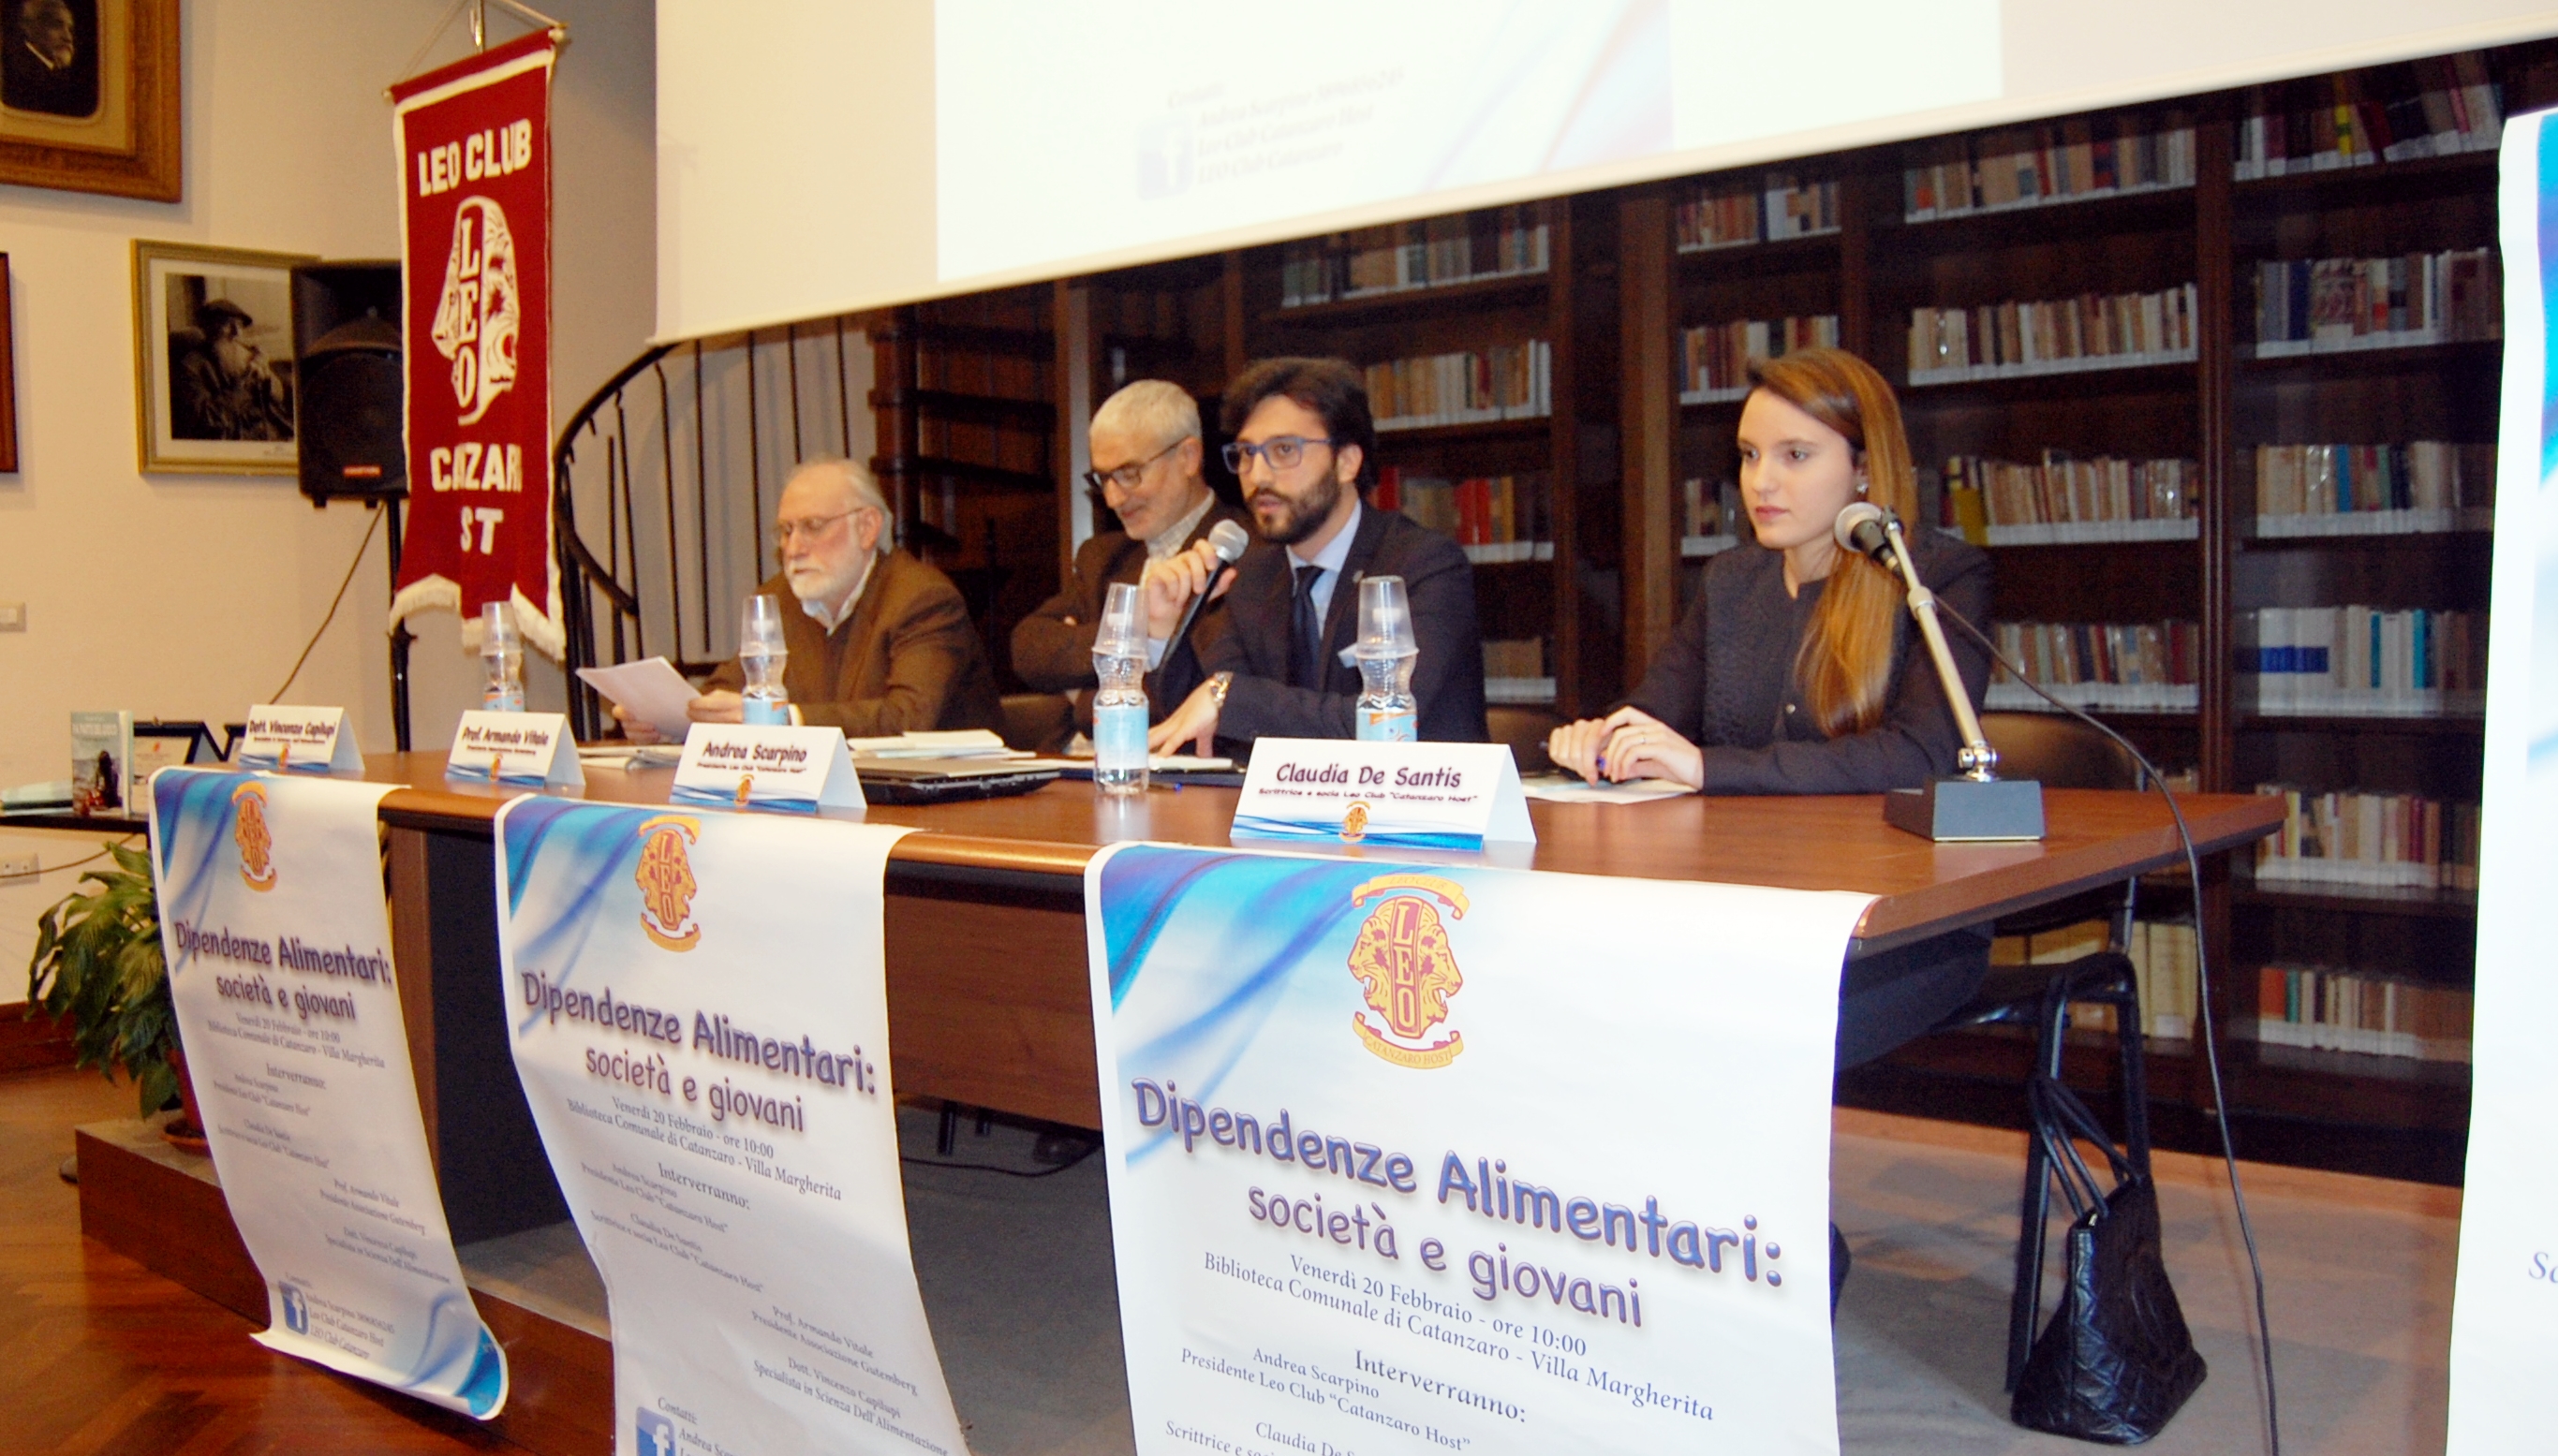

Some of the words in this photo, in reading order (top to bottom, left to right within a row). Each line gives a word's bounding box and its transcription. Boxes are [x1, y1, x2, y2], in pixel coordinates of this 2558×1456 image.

[418, 140, 460, 198] LEO
[465, 118, 532, 181] CLUB
[457, 217, 481, 410] LEO
[702, 741, 747, 759] Andrea
[752, 744, 807, 767] Scarpino
[1276, 762, 1349, 785] Claudia
[1358, 766, 1385, 785] De
[1395, 766, 1461, 788] Santis
[659, 834, 674, 923] LEO
[174, 920, 273, 965] Dipendenze
[279, 937, 392, 984] Alimentari:
[1394, 904, 1415, 1029] LEO
[216, 974, 273, 1006] società
[278, 991, 288, 1008] e
[296, 985, 356, 1021] giovani
[521, 970, 682, 1045] Dipendenze
[693, 1009, 877, 1096] Alimentari:
[1366, 1035, 1423, 1066] CATANZARO
[1423, 1051, 1451, 1066] HOST
[585, 1047, 672, 1096] società
[683, 1074, 698, 1102] e
[710, 1078, 805, 1133] giovani
[567, 1097, 614, 1125] Biblioteca
[614, 1115, 665, 1142] Comunale
[668, 1131, 678, 1147] di
[679, 1136, 735, 1165] Catanzaro
[745, 1156, 772, 1178] Villa
[775, 1166, 842, 1200] Margherita
[613, 1096, 650, 1120] Venerdì
[654, 1110, 665, 1125] 20
[668, 1112, 713, 1140] Febbraio
[723, 1134, 740, 1149] ore
[745, 1138, 774, 1158] 10:00
[658, 1162, 750, 1210] Interverranno:
[1131, 1077, 1417, 1194] Dipendenze
[1437, 1150, 1784, 1288] Alimentari:
[1248, 1184, 1398, 1260] società
[1420, 1237, 1447, 1272] e
[1468, 1242, 1642, 1328] giovani
[773, 1305, 795, 1326] Prof.
[798, 1317, 842, 1345] Armando
[844, 1336, 873, 1358] Vitale
[1204, 1252, 1284, 1292] Biblioteca
[1289, 1277, 1379, 1321] Comunale
[1383, 1305, 1402, 1329] di
[1408, 1314, 1510, 1360] Catanzaro
[1530, 1349, 1579, 1382] Villa
[1587, 1366, 1714, 1421] Margherita
[1290, 1254, 1357, 1291] Venerdì
[1363, 1275, 1384, 1299] 20
[1390, 1284, 1473, 1325] Febbraio
[1493, 1319, 1524, 1340] ore
[1530, 1325, 1587, 1357] 10:00
[752, 1310, 797, 1340] Presidente
[801, 1333, 859, 1368] Associazione
[754, 1359, 802, 1391] Specialista
[804, 1382, 813, 1396] in
[815, 1387, 850, 1413] Scienza
[788, 1357, 812, 1376] Dott.
[814, 1368, 856, 1397] Vincenzo
[858, 1390, 901, 1419] Capilupi
[1181, 1347, 1256, 1383] Presidente
[1260, 1371, 1286, 1393] Leo
[1289, 1381, 1325, 1405] Club
[1253, 1347, 1308, 1376] Andrea
[1311, 1365, 1380, 1399] Scarpino
[1355, 1349, 1526, 1422] Interverranno:
[679, 1428, 712, 1452] Andrea
[1166, 1420, 1232, 1453] Scrittrice
[1255, 1421, 1316, 1453] Claudia
